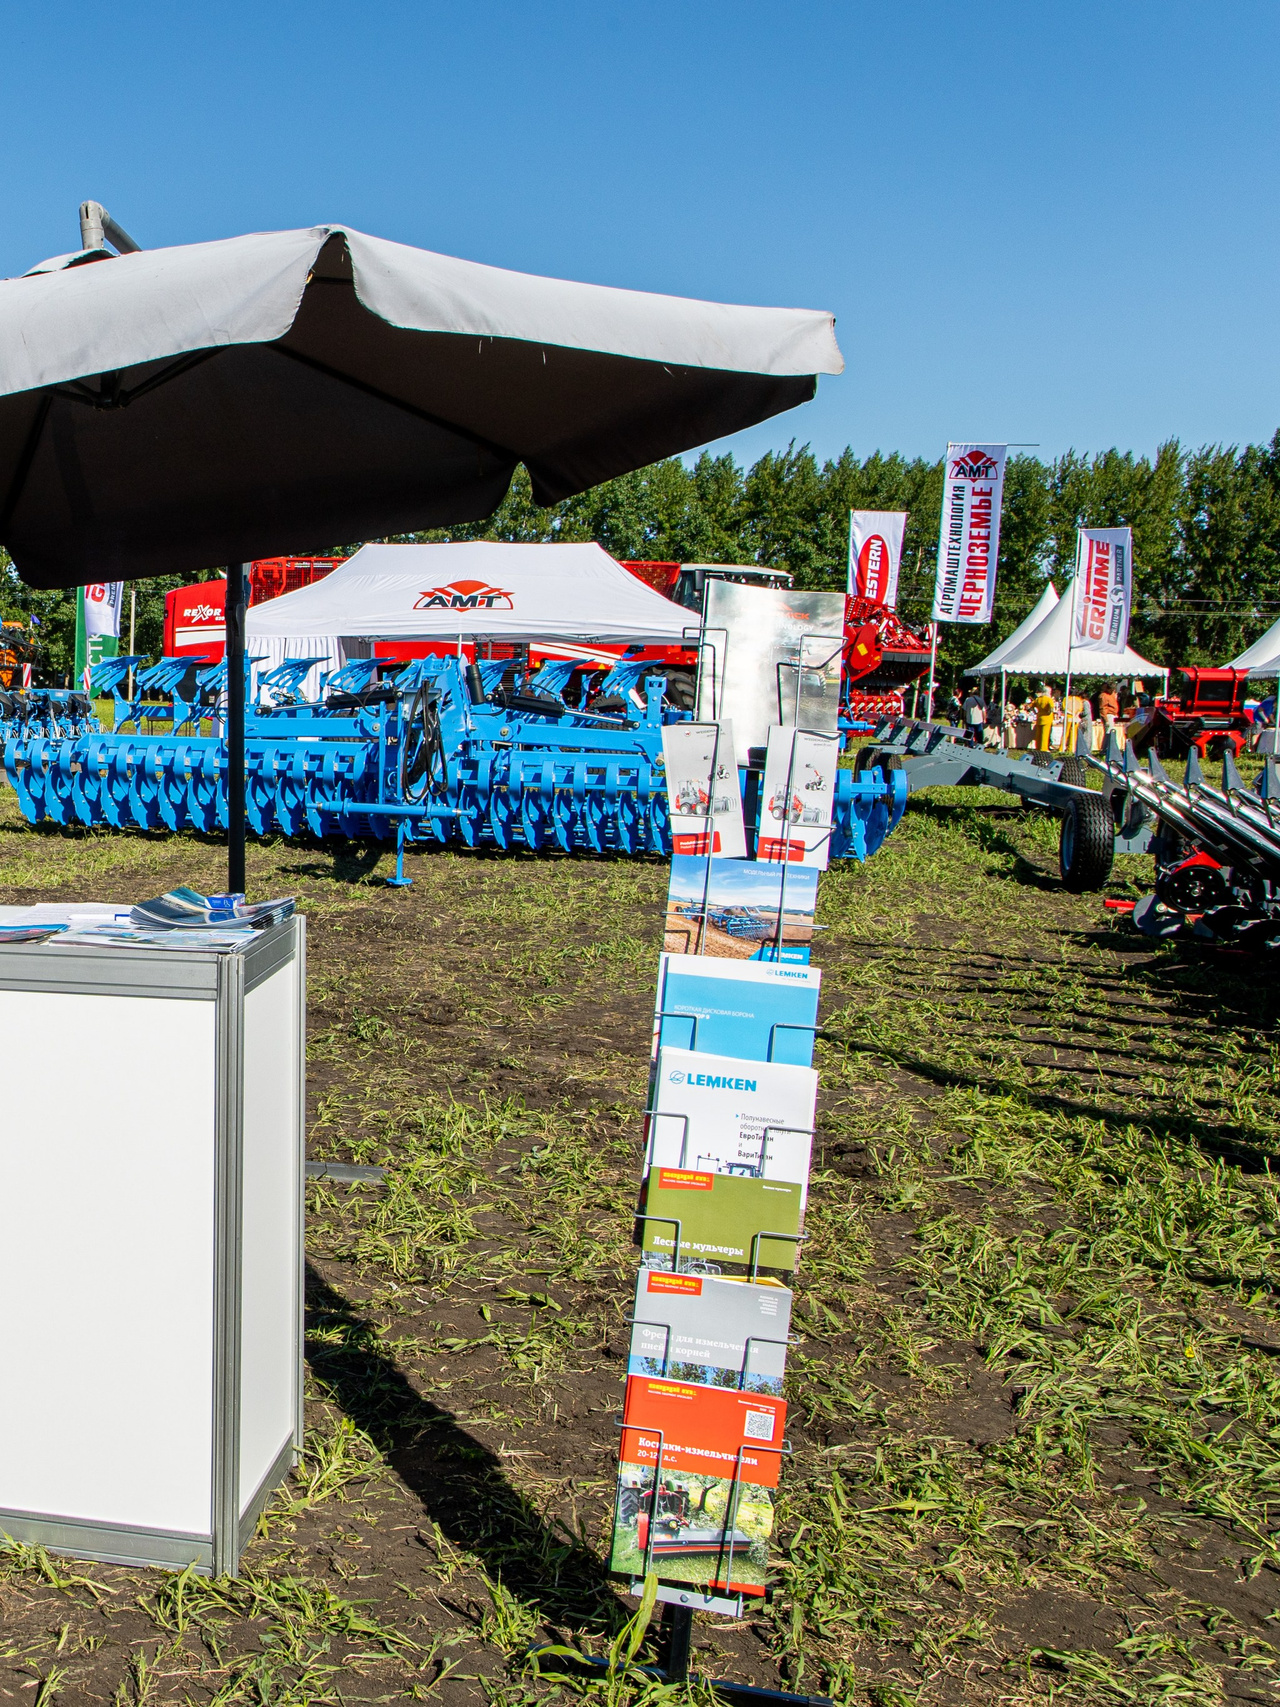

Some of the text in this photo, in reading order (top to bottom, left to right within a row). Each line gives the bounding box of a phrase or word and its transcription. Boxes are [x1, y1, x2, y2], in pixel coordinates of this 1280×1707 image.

[939, 485, 966, 615] АГРОМАШТЕХНОЛОГИЯ
[958, 486, 993, 617] ЧЕРНОЗЕМЬЕ
[865, 538, 883, 599] ESTERN
[1088, 540, 1110, 641] GRIMME
[183, 604, 222, 623] REXOR
[1109, 608, 1120, 642] PREMIUM
[774, 951, 804, 960] LMKEN
[775, 970, 808, 979] LEMKEN
[687, 1073, 757, 1092] LEMKEN
[741, 1113, 785, 1125] Полунавесные
[739, 1132, 774, 1141] ЕвроТиан
[737, 1150, 773, 1160] ВариТиан
[692, 1241, 744, 1256] мульчеры
[642, 1328, 759, 1354] Фрез для измельченя
[675, 1345, 711, 1359] корней
[637, 1450, 660, 1460] 20-12
